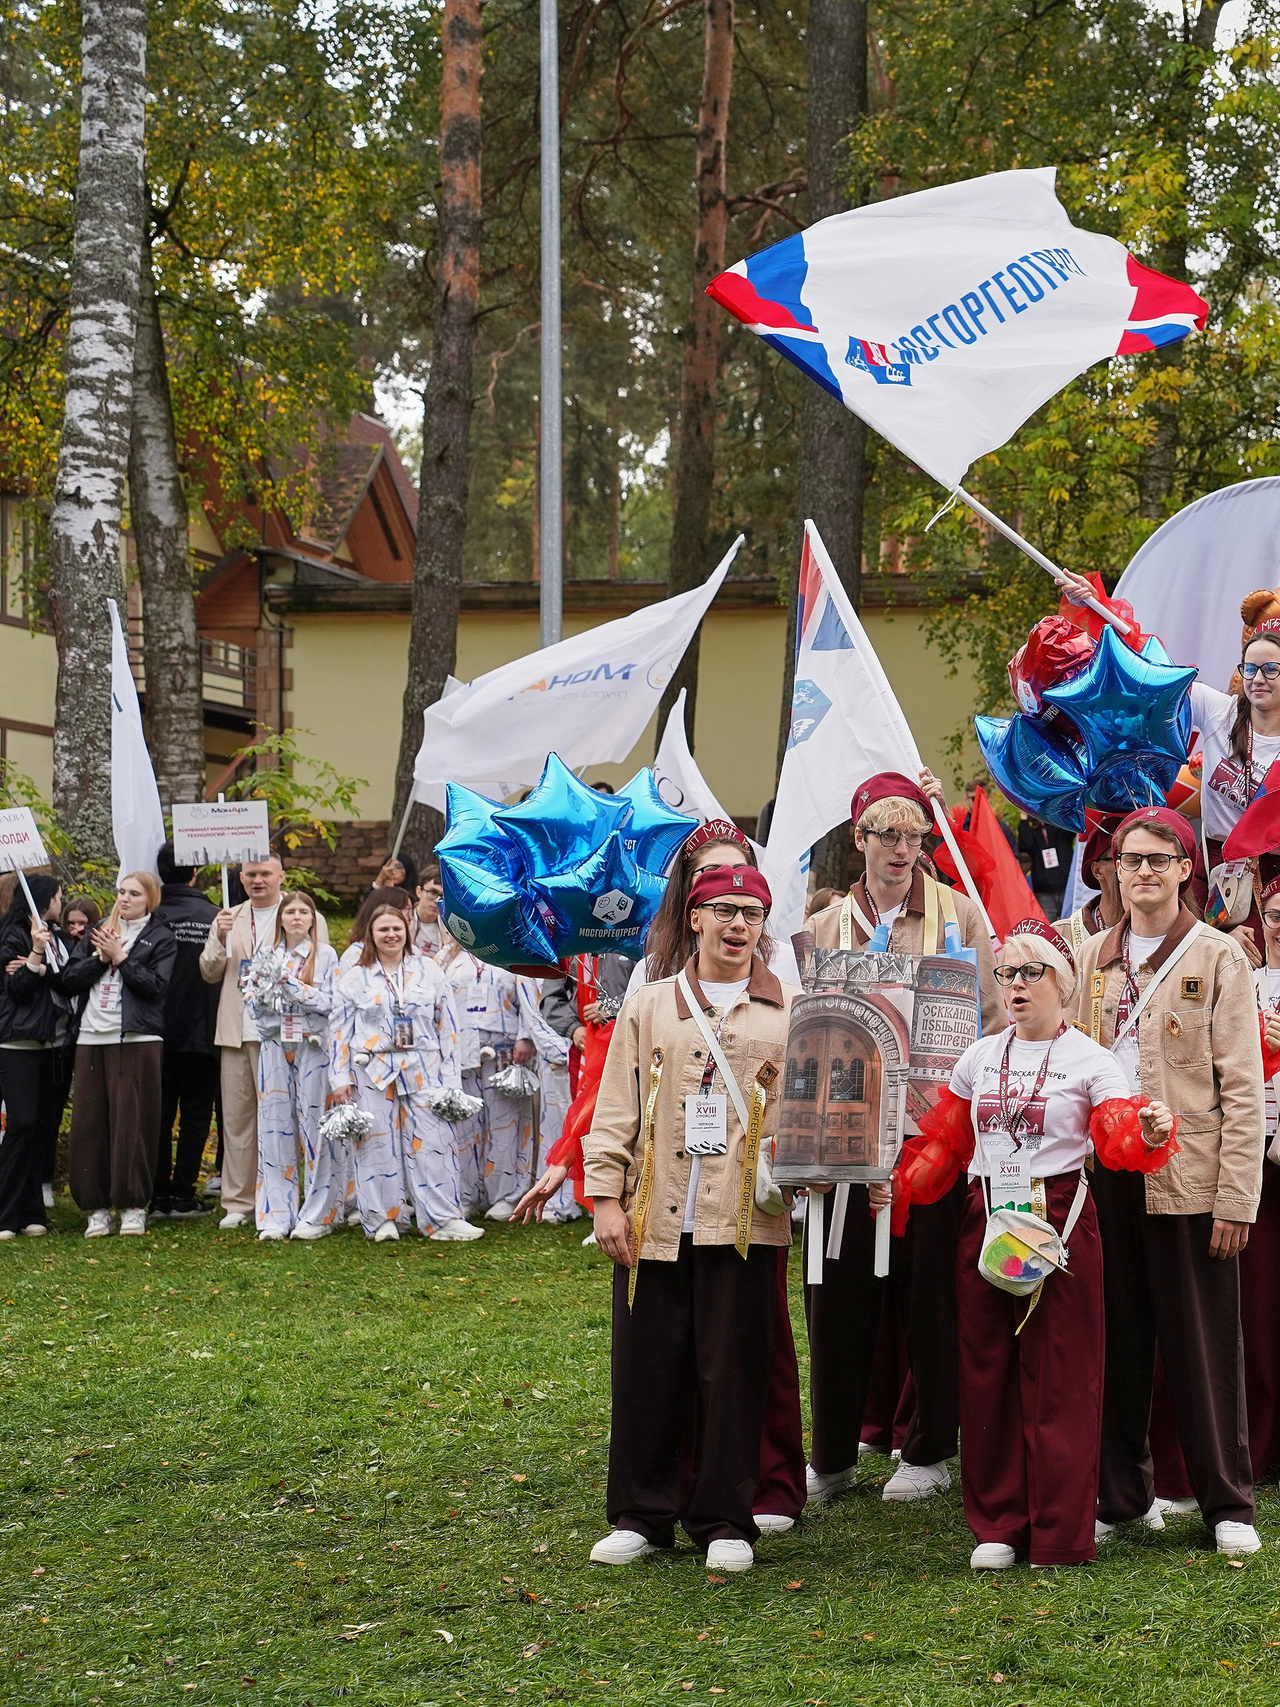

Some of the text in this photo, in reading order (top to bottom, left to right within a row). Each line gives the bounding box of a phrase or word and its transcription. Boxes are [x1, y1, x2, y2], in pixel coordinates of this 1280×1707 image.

[578, 926, 640, 938] МОСГОРГЕОТРЕСТ
[696, 1106, 717, 1114] XVIII
[748, 1085, 765, 1161] МОСГОРГЕОТРЕСТ
[1000, 1165, 1020, 1173] XVIII
[738, 1167, 753, 1248] МОСГОРГЕОТРЕСТ
